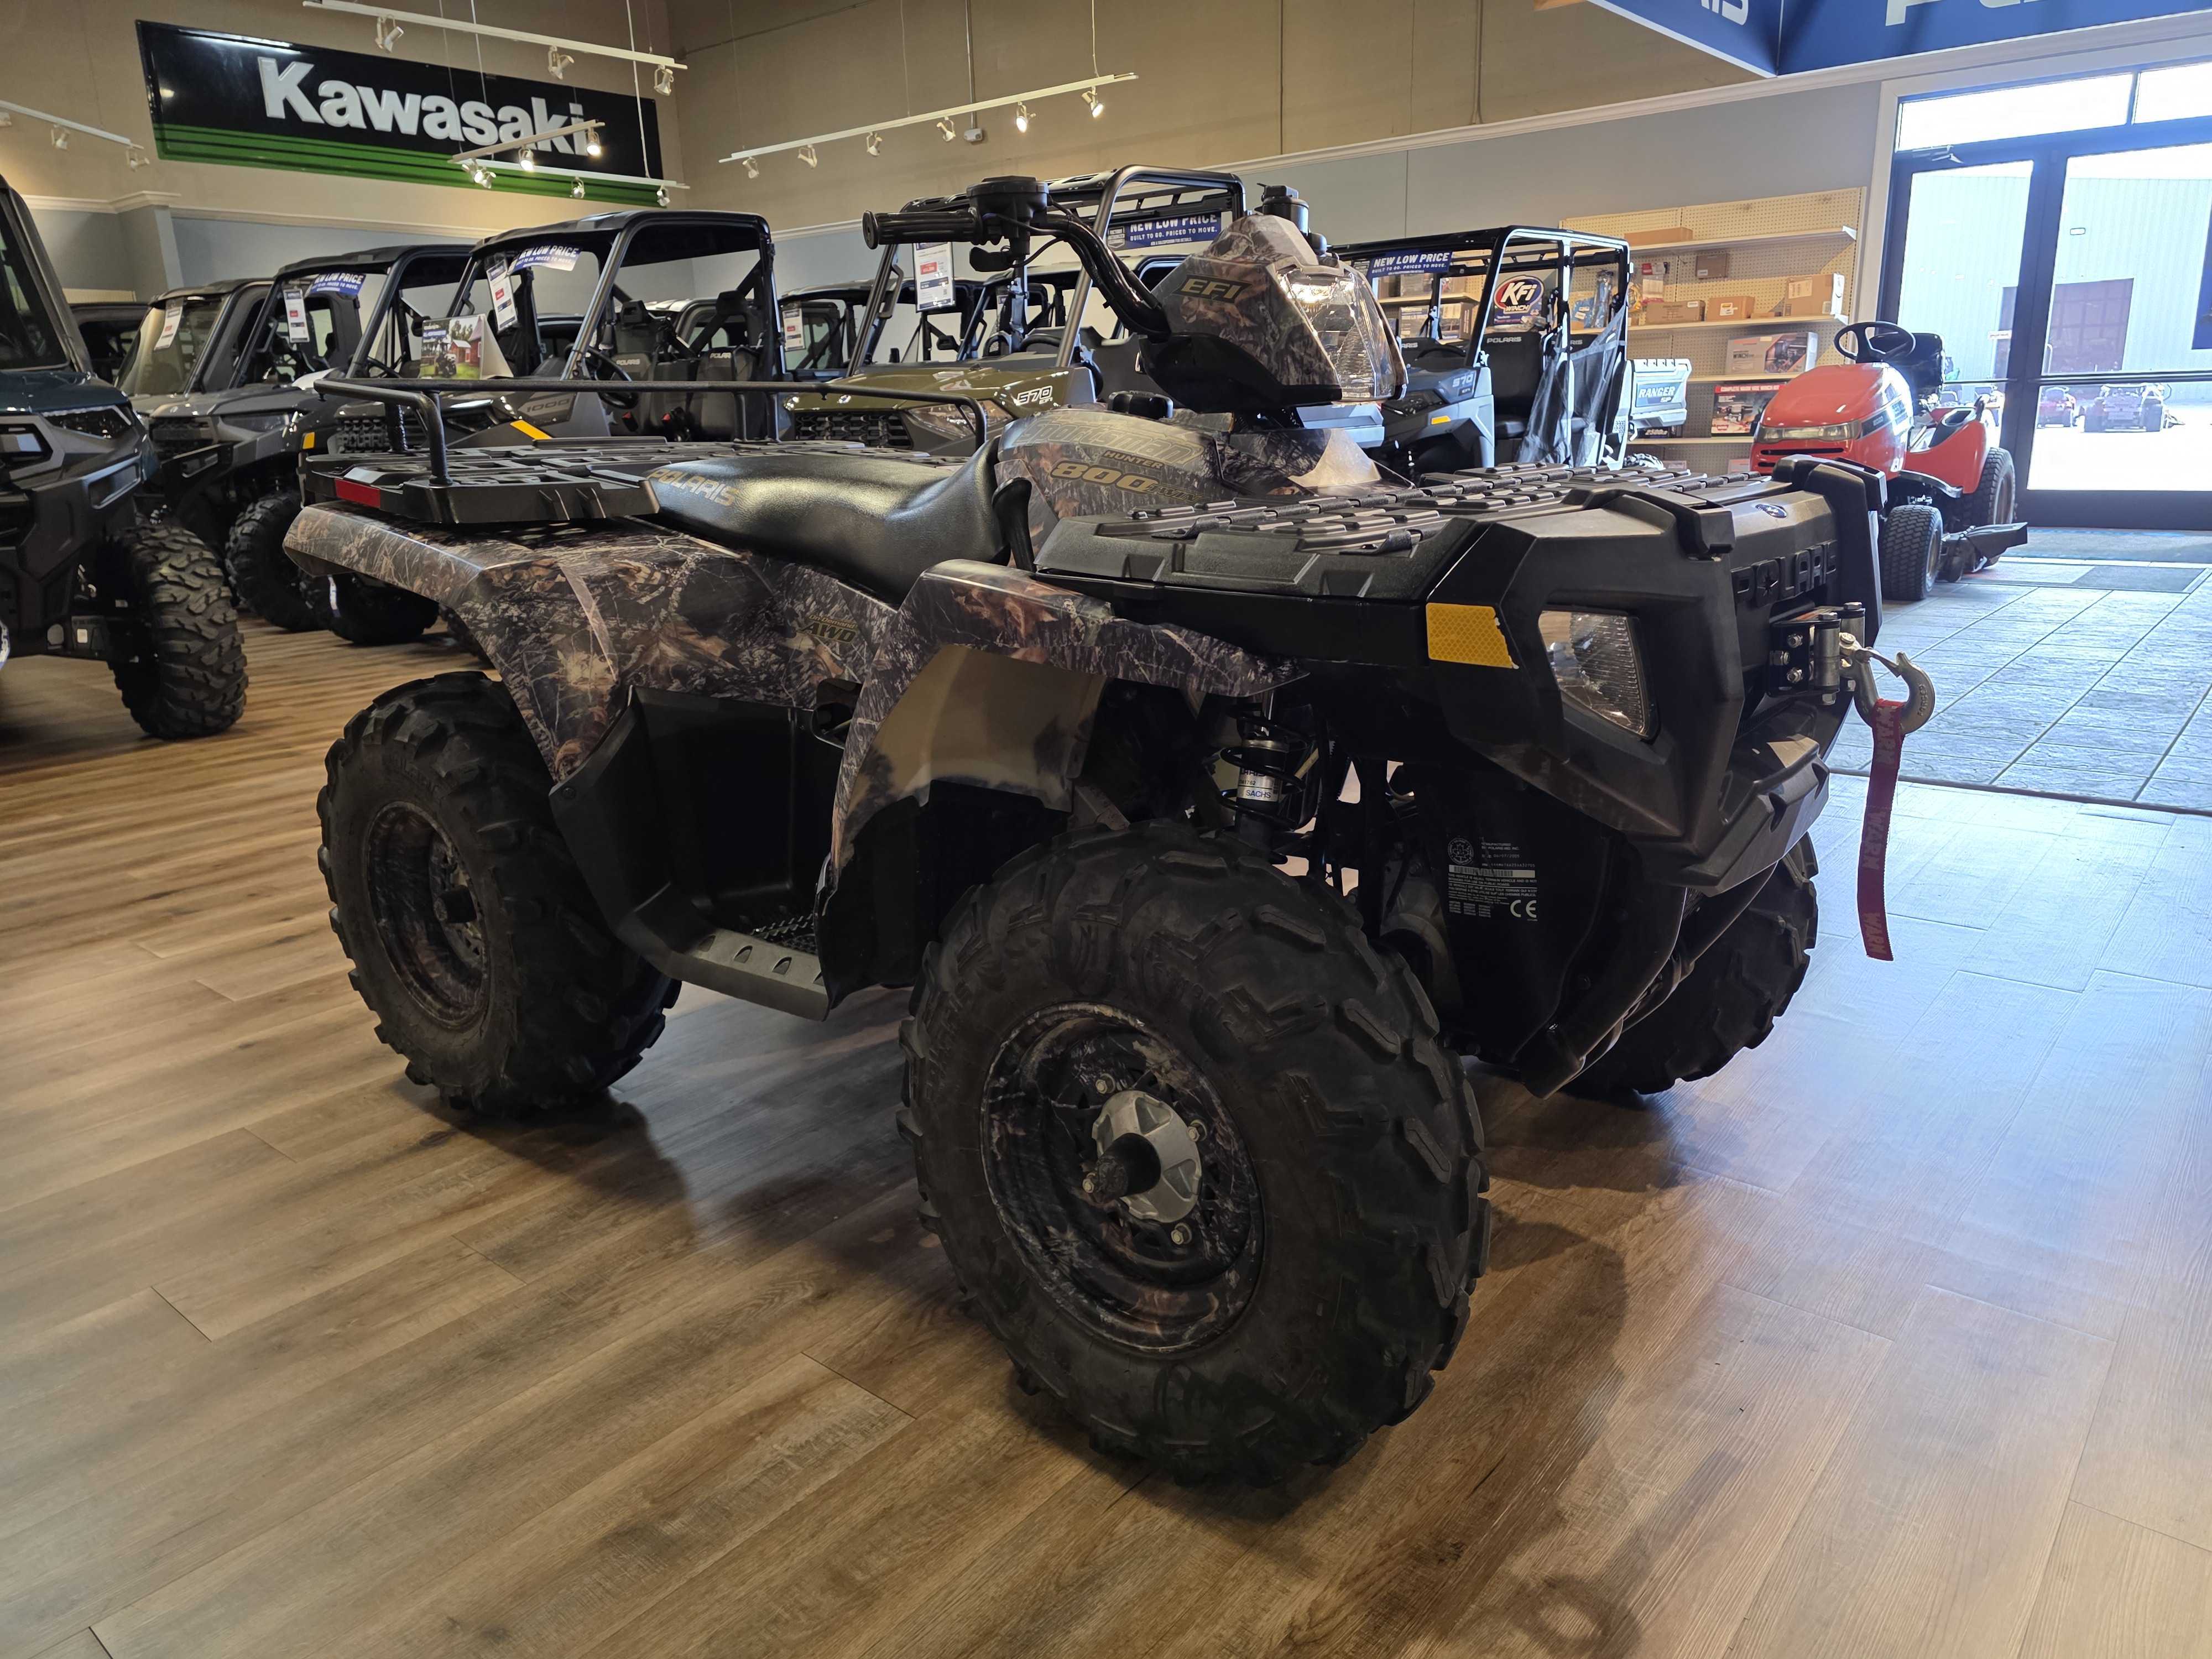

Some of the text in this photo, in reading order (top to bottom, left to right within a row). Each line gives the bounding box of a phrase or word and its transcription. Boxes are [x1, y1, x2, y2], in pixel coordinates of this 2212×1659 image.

[257, 56, 590, 156] Kawasaki
[1130, 221, 1153, 232] NEW
[1156, 218, 1178, 229] LOW
[1166, 229, 1187, 237] PRICED
[550, 246, 579, 258] PRICE
[1374, 252, 1450, 268] NEW LOW PRICE
[338, 273, 364, 284] PRICE
[1180, 279, 1242, 299] EFI
[1452, 374, 1474, 388] 570
[1016, 385, 1053, 406] 570
[1639, 387, 1676, 398] RANGER
[527, 399, 570, 413] 1000
[1016, 419, 1194, 465] Sportsman
[1104, 450, 1163, 469] HUNTER
[646, 468, 740, 506] POLARIS
[1052, 462, 1205, 502] 800 TWIN
[802, 622, 857, 643] AWD
[1245, 790, 1271, 799] SACHS
[1863, 810, 1886, 870] WARN
[1510, 899, 1537, 918] CE
[1864, 912, 1886, 956] WARN
